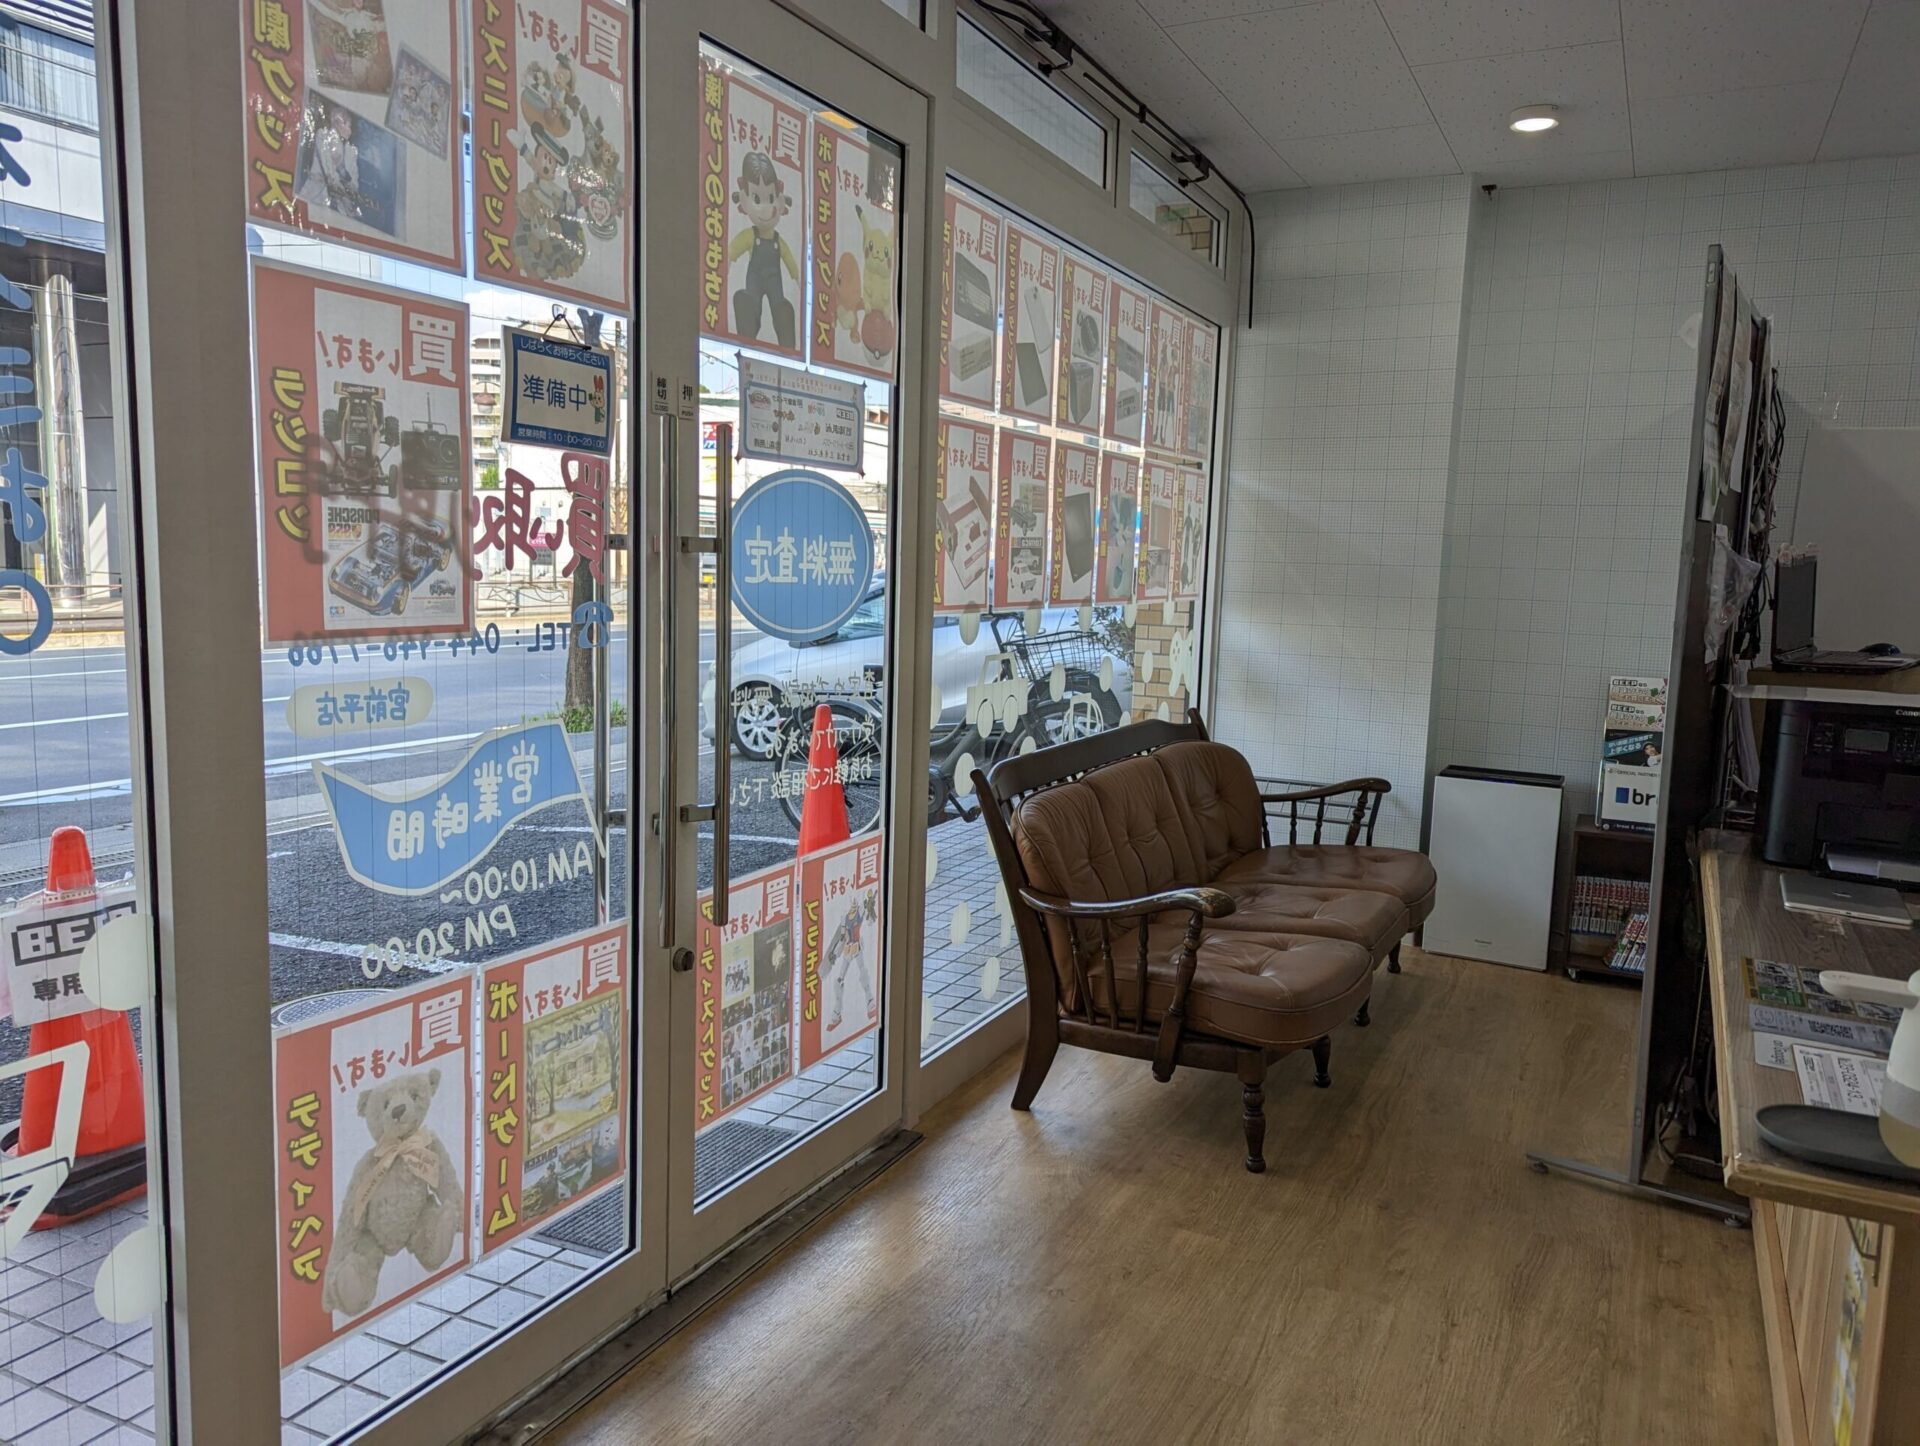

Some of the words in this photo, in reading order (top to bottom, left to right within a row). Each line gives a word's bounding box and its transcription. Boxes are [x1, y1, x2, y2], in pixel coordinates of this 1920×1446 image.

[522, 373, 587, 412] 準備中
[682, 384, 693, 401] 押
[1895, 709, 1920, 717] Cano
[11, 900, 137, 966] BE
[32, 972, 85, 1002] 専用
